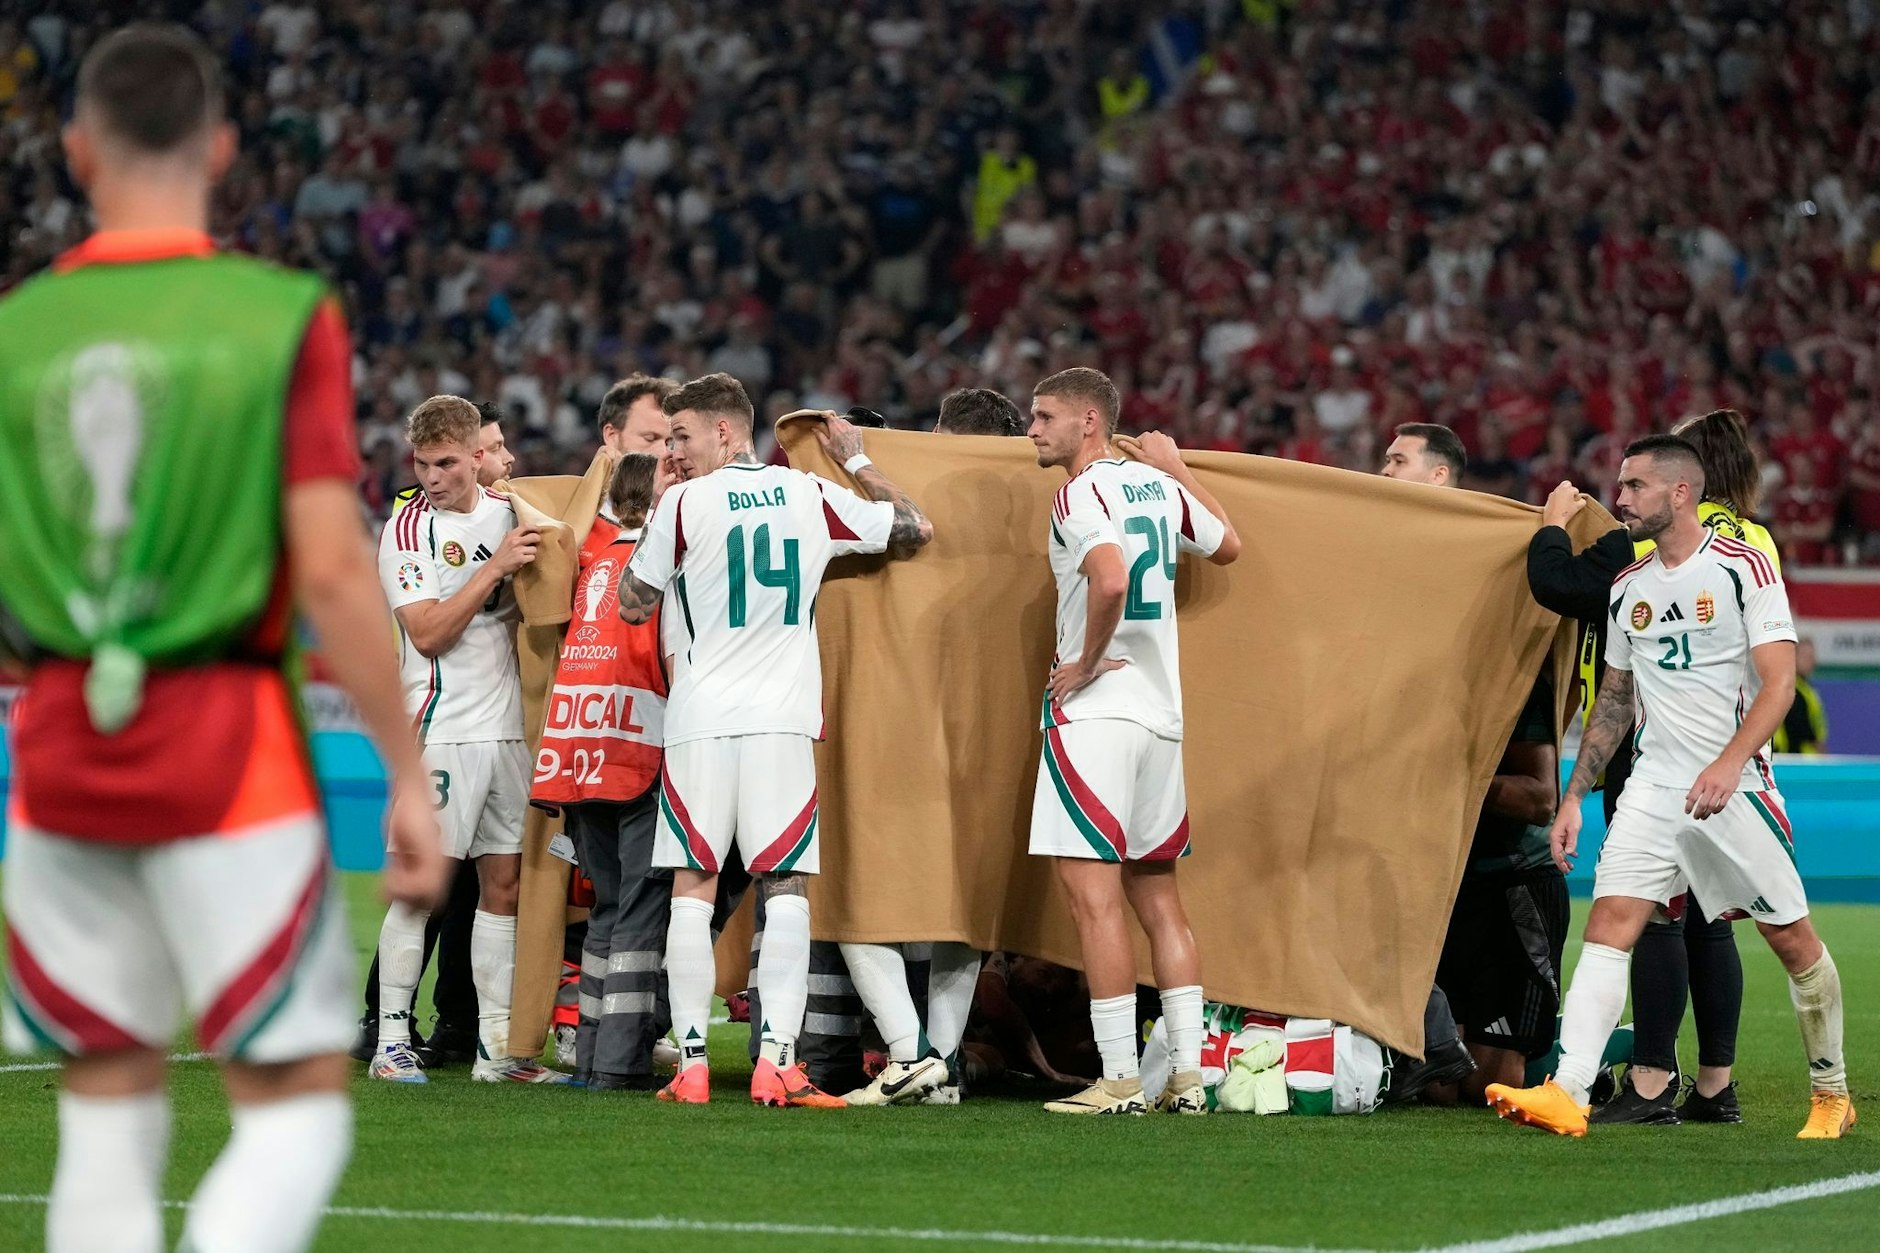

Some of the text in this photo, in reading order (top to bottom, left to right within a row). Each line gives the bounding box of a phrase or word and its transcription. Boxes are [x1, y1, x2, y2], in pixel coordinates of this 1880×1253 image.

[728, 486, 786, 511] BOLLA
[727, 523, 800, 628] 14
[1124, 516, 1180, 620] 24
[1658, 633, 1692, 670] 21
[547, 692, 643, 734] DICAL
[534, 748, 606, 785] 9-02
